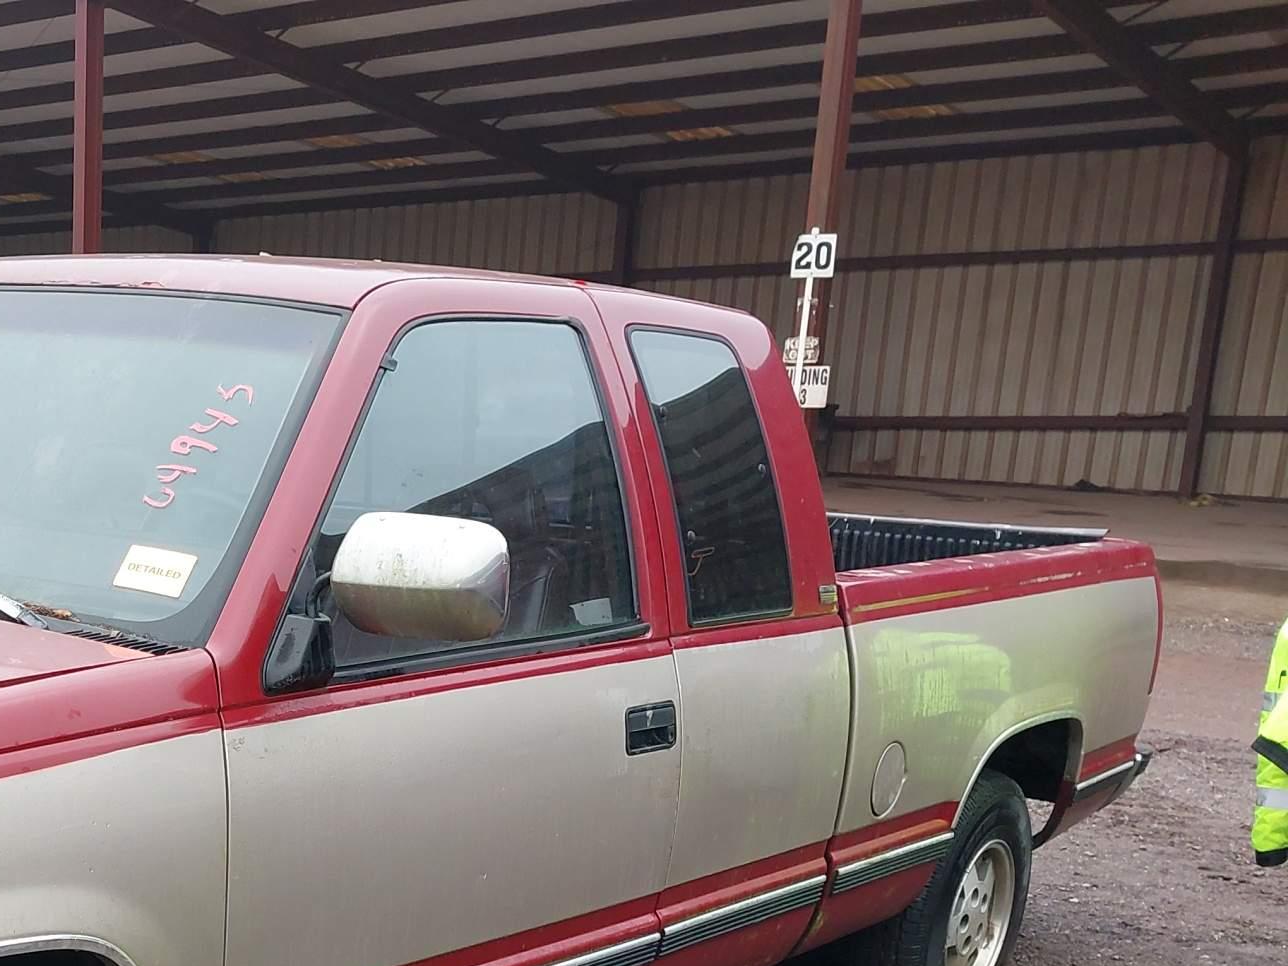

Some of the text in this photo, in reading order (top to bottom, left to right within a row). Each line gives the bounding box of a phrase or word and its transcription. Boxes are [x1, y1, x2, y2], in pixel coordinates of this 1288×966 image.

[795, 242, 833, 270] 20
[789, 350, 814, 360] OT
[800, 388, 807, 405] 3
[127, 561, 182, 580] DETAILED
